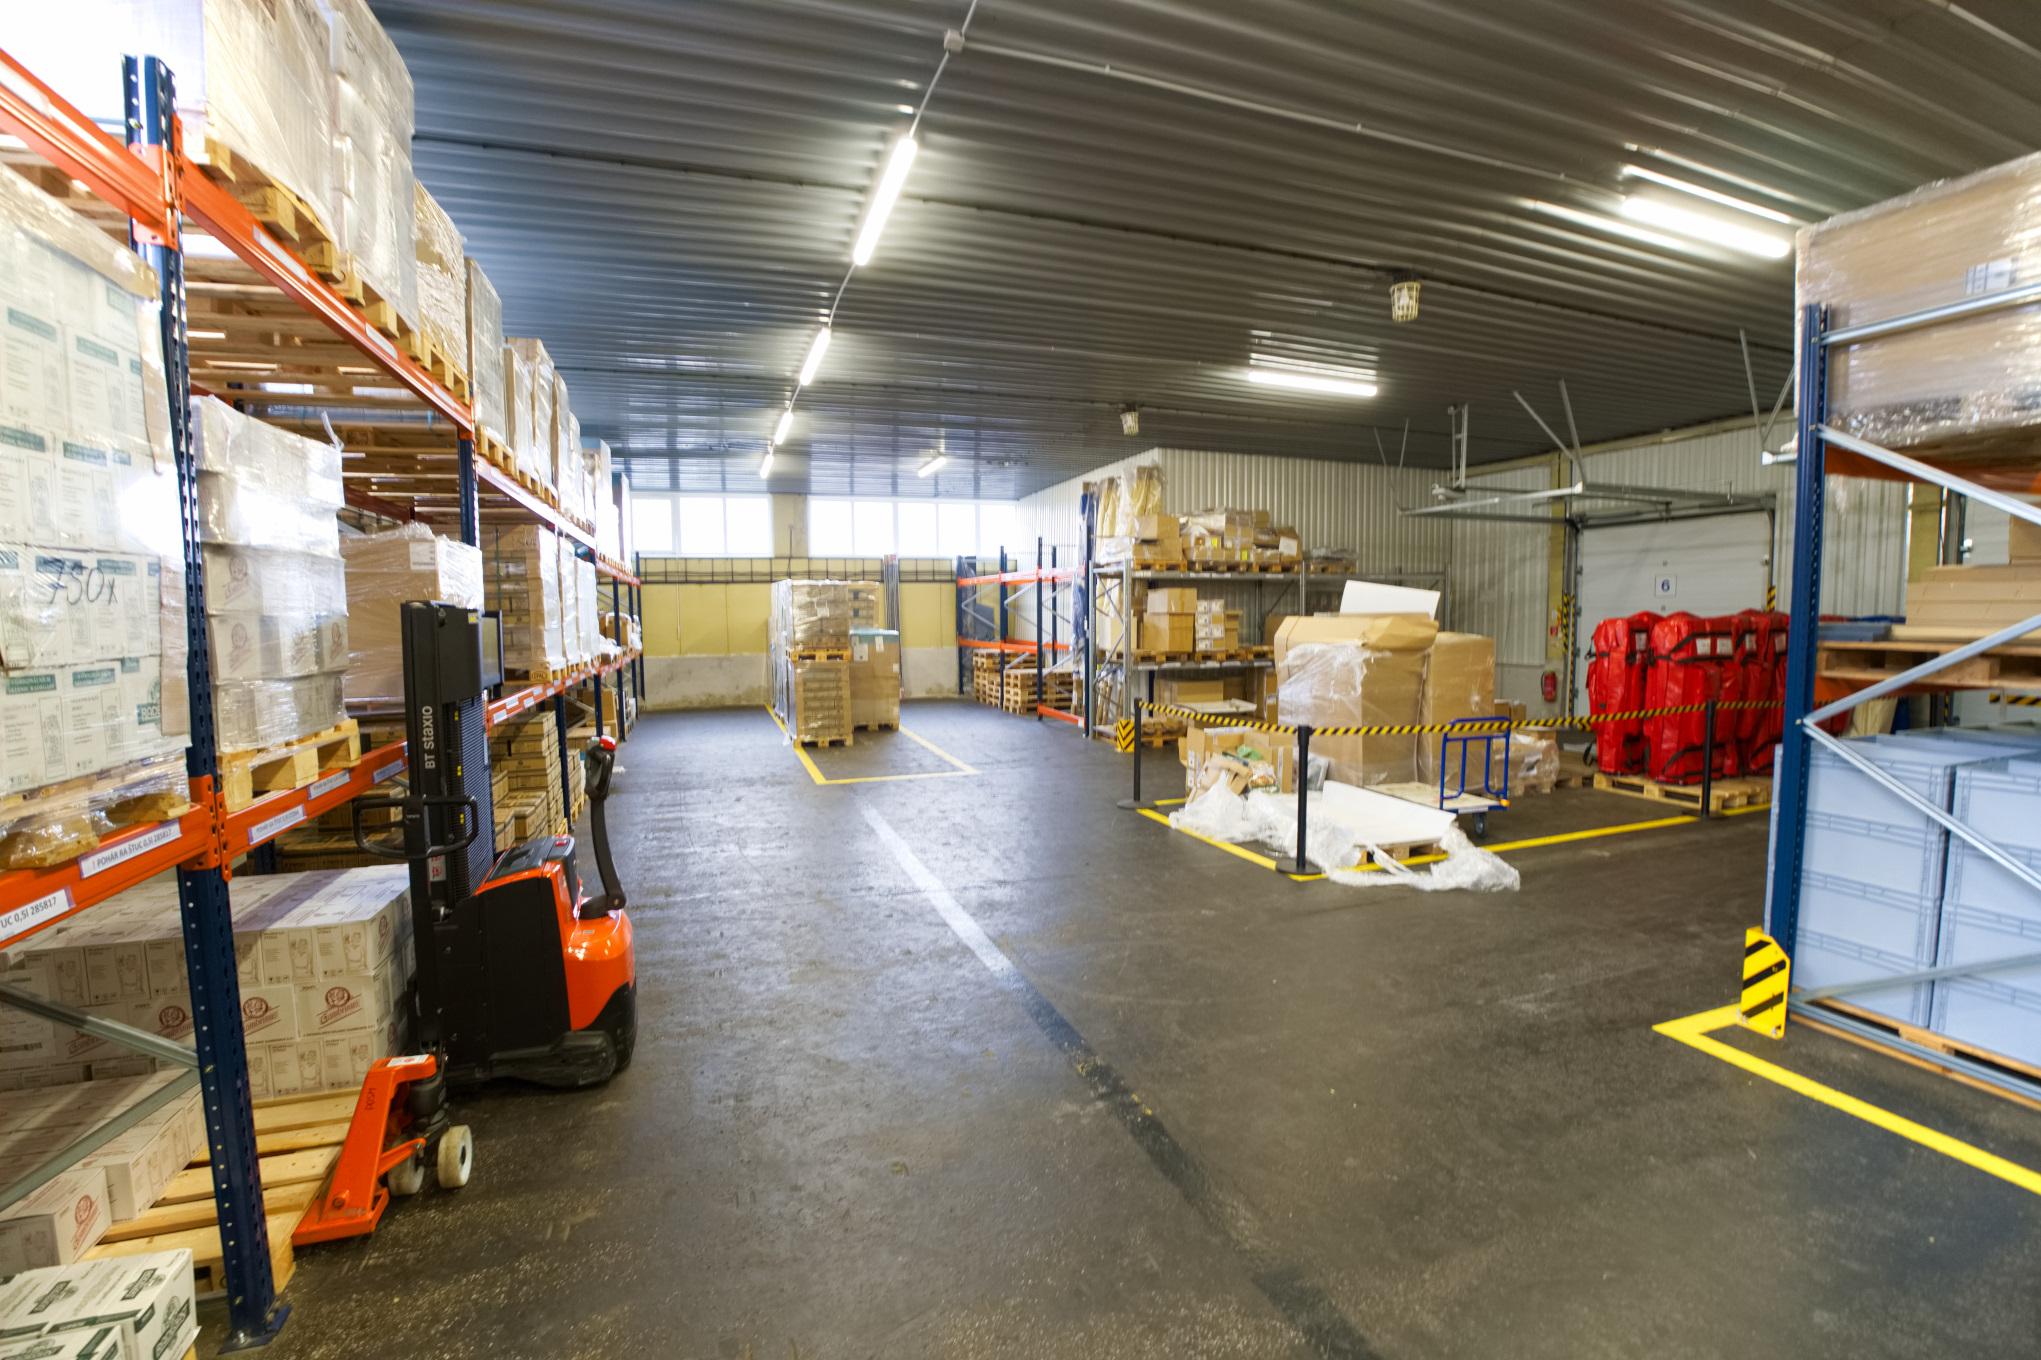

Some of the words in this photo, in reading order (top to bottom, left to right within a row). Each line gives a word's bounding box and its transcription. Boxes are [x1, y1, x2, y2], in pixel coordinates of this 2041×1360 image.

[1661, 580, 1670, 592] 6
[425, 752, 436, 769] BT
[30, 896, 57, 916] 285817
